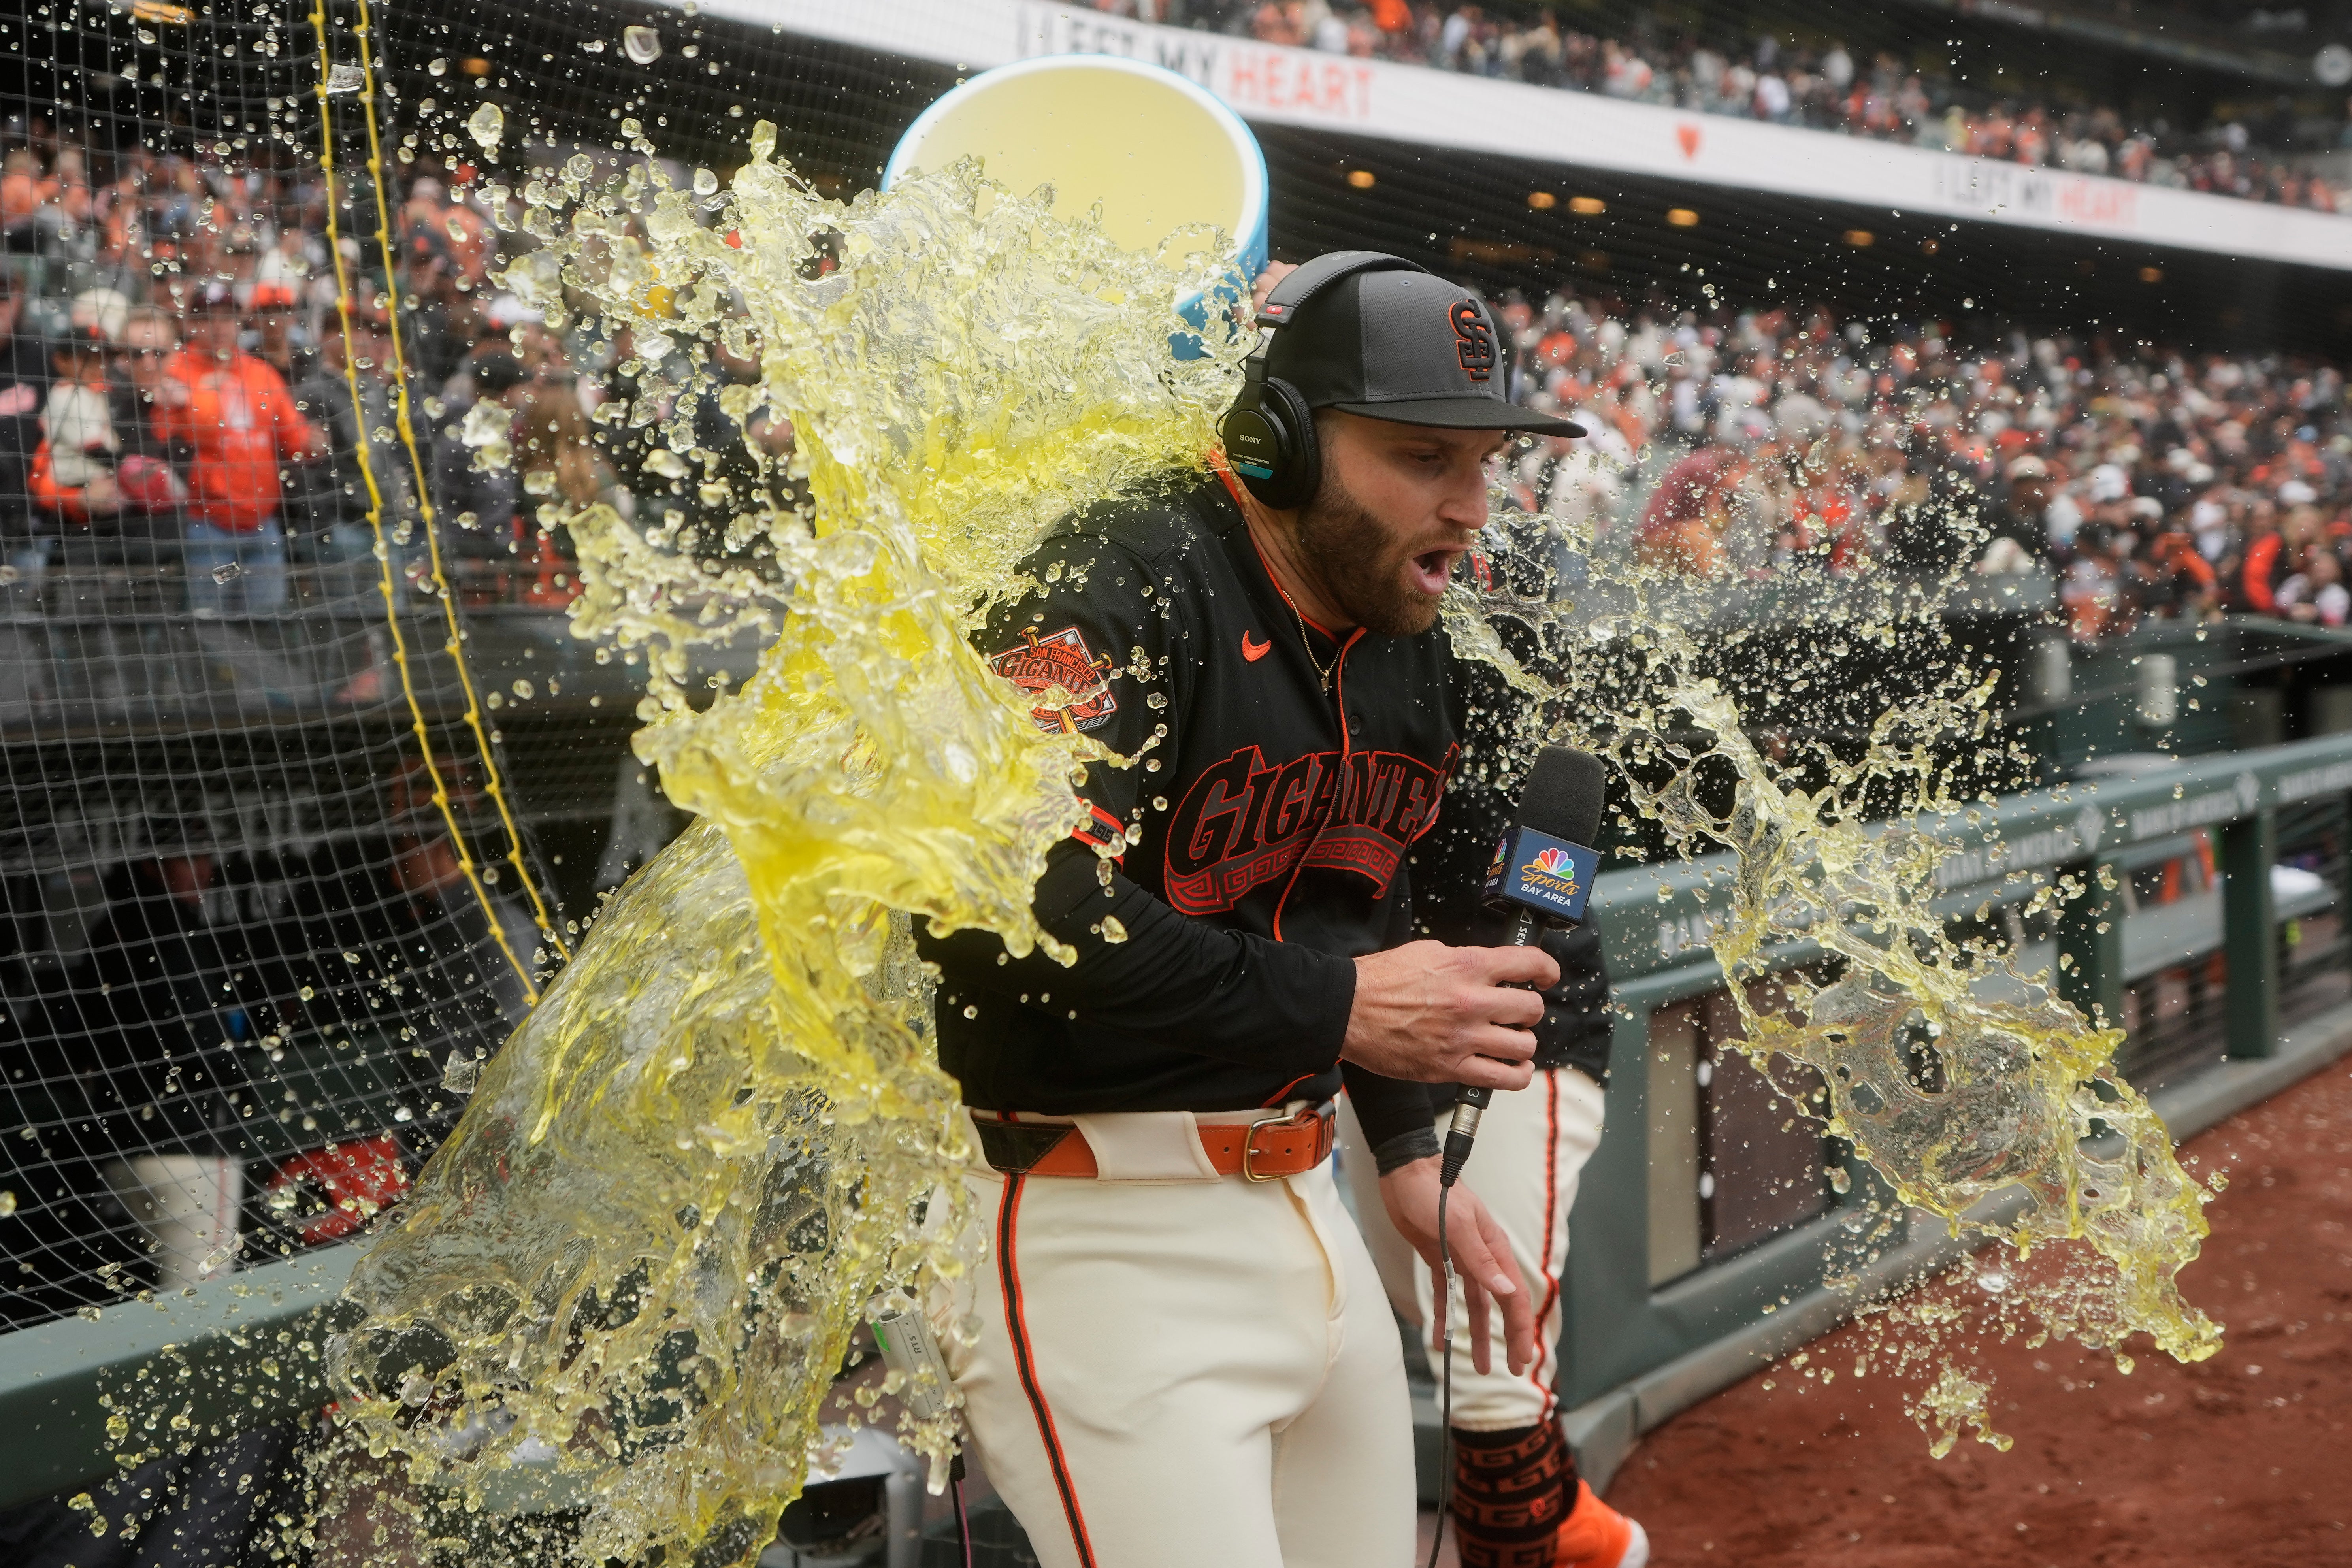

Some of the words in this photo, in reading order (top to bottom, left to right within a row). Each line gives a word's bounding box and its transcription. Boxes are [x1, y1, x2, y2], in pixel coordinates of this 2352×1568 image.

[1228, 48, 1376, 118] HEART
[1239, 434, 1261, 444] SONY
[1029, 646, 1048, 658] SAN
[1049, 648, 1096, 680] FRANCISCO
[1521, 864, 1580, 895] Sports
[1521, 883, 1543, 896] BAY
[1542, 891, 1571, 907] AREA
[1515, 926, 1528, 946] SEN
[909, 1336, 922, 1354] RTS
